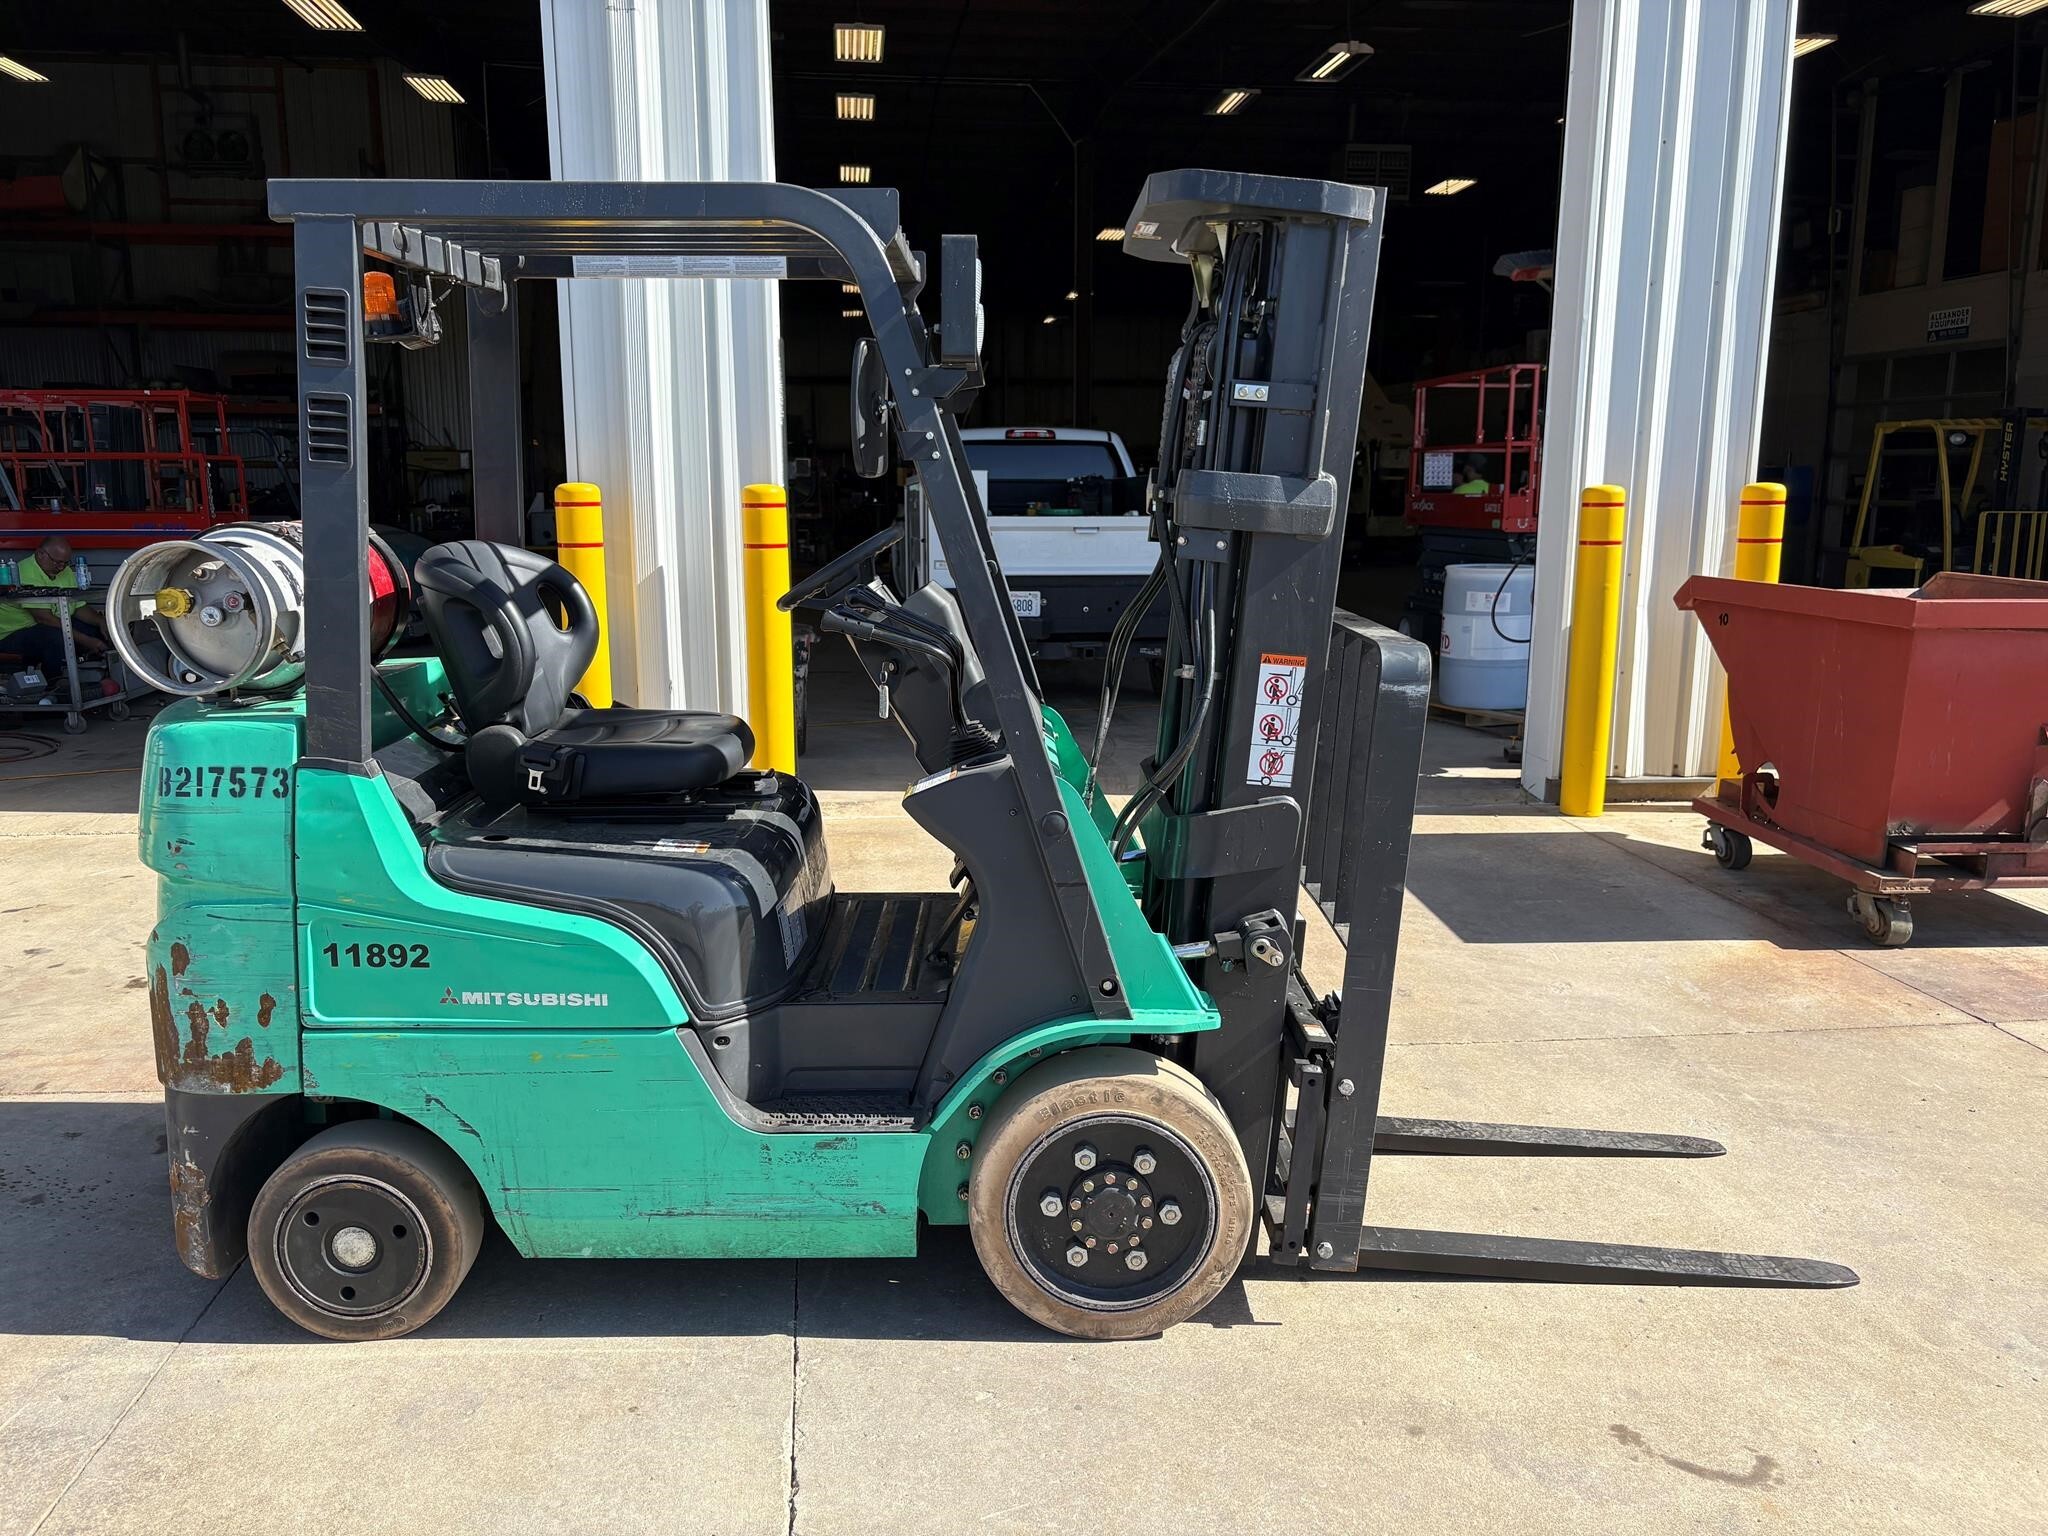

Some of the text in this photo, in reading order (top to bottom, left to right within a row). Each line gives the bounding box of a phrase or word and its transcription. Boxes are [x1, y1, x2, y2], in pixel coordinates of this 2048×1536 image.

[2000, 422, 2014, 481] HYSTER
[1718, 612, 1729, 626] 10
[1272, 657, 1305, 667] WARNING
[159, 766, 290, 798] B217573
[323, 942, 430, 968] 11892
[461, 991, 609, 1007] MITSUBISHI
[1040, 1089, 1126, 1120] Elastic
